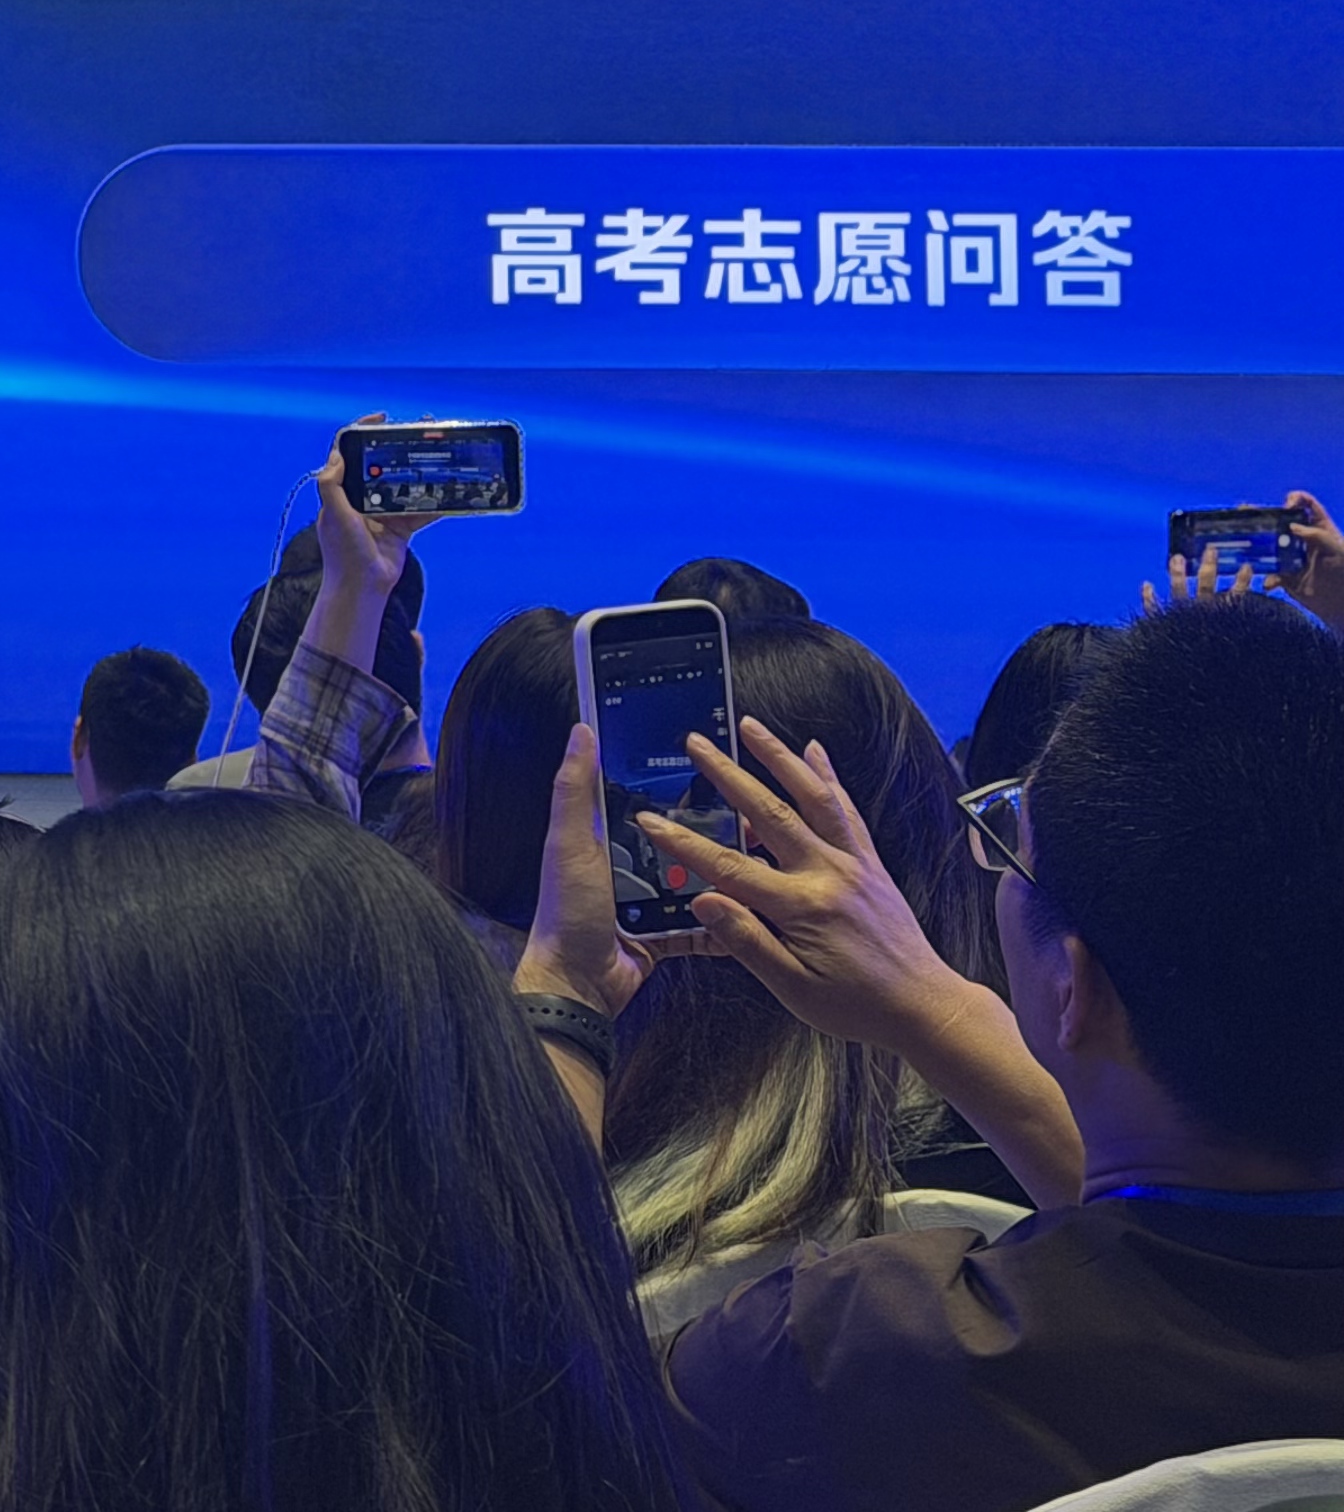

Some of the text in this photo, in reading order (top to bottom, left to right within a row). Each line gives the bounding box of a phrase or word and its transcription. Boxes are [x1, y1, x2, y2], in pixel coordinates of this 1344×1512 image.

[486, 207, 1132, 305] 高考志愿问答
